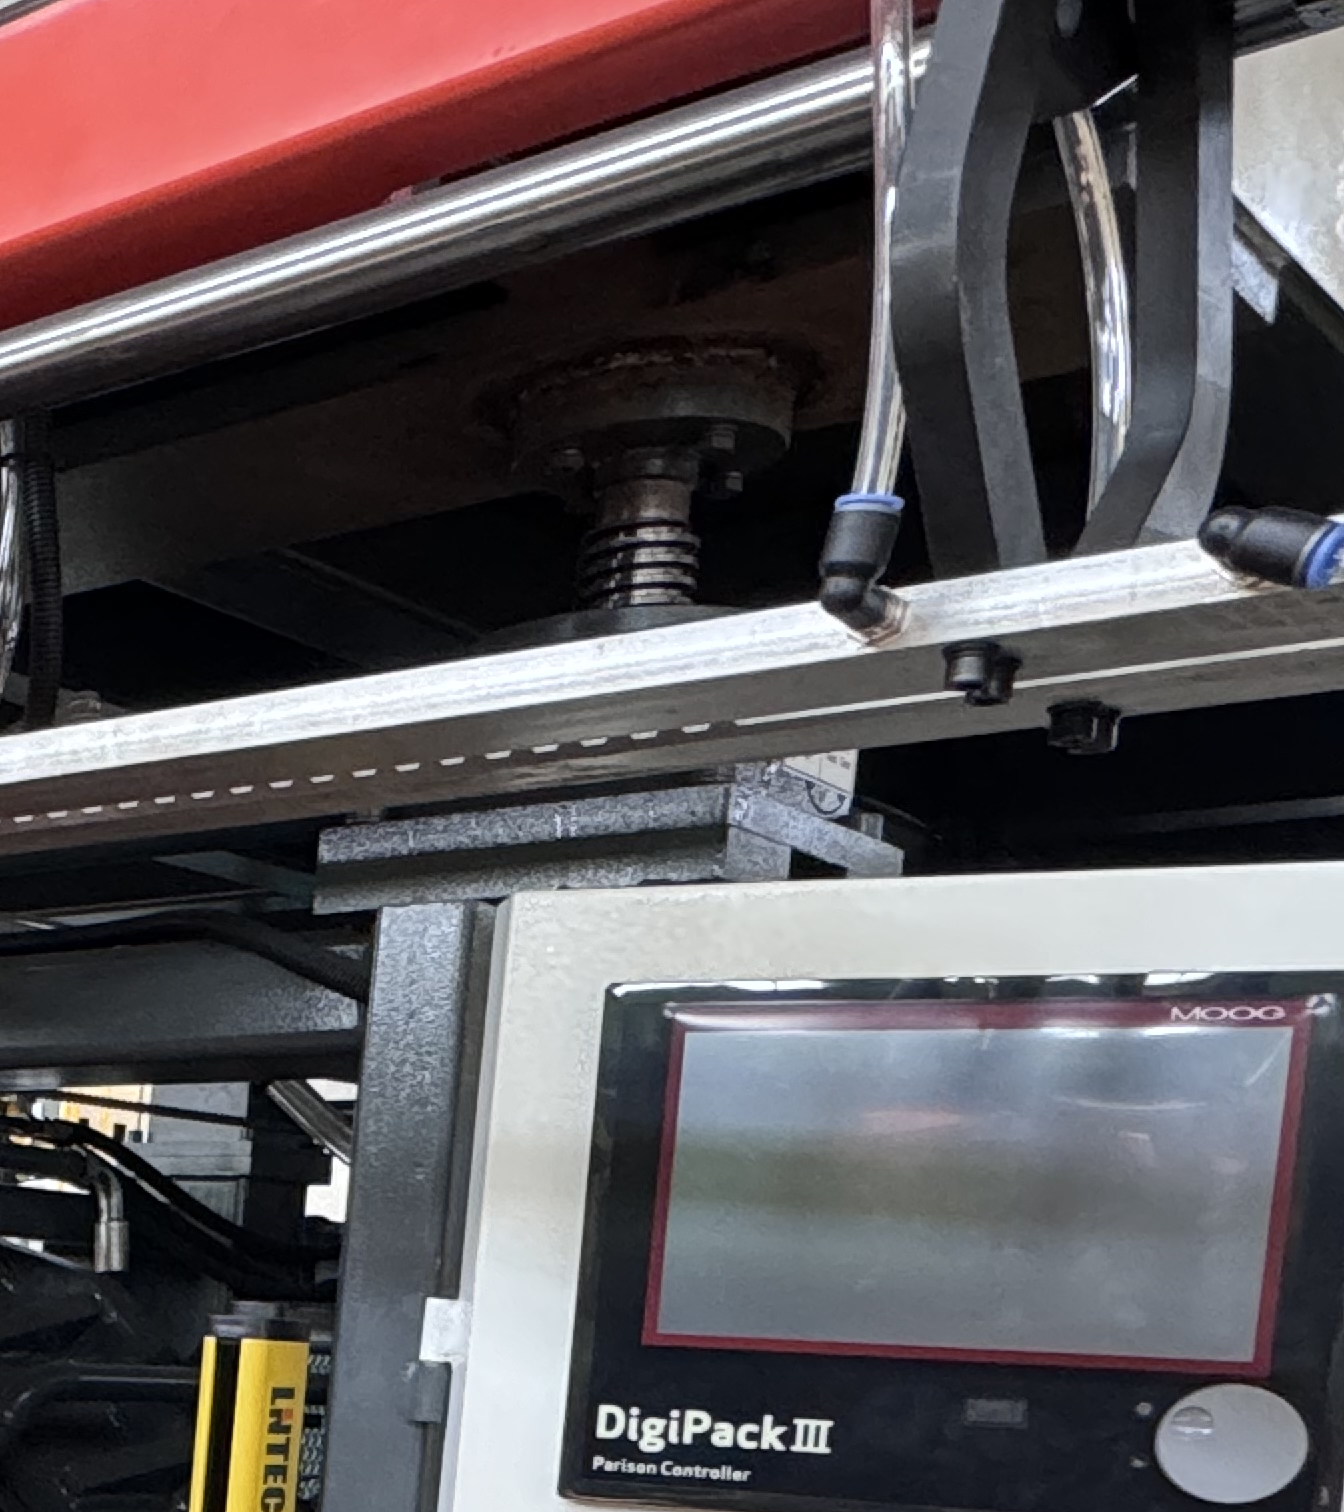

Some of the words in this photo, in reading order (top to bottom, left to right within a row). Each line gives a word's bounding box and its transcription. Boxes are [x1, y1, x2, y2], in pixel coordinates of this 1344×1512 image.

[1170, 1005, 1286, 1021] MOOG
[592, 1455, 658, 1475] Parison
[660, 1460, 752, 1482] Controller
